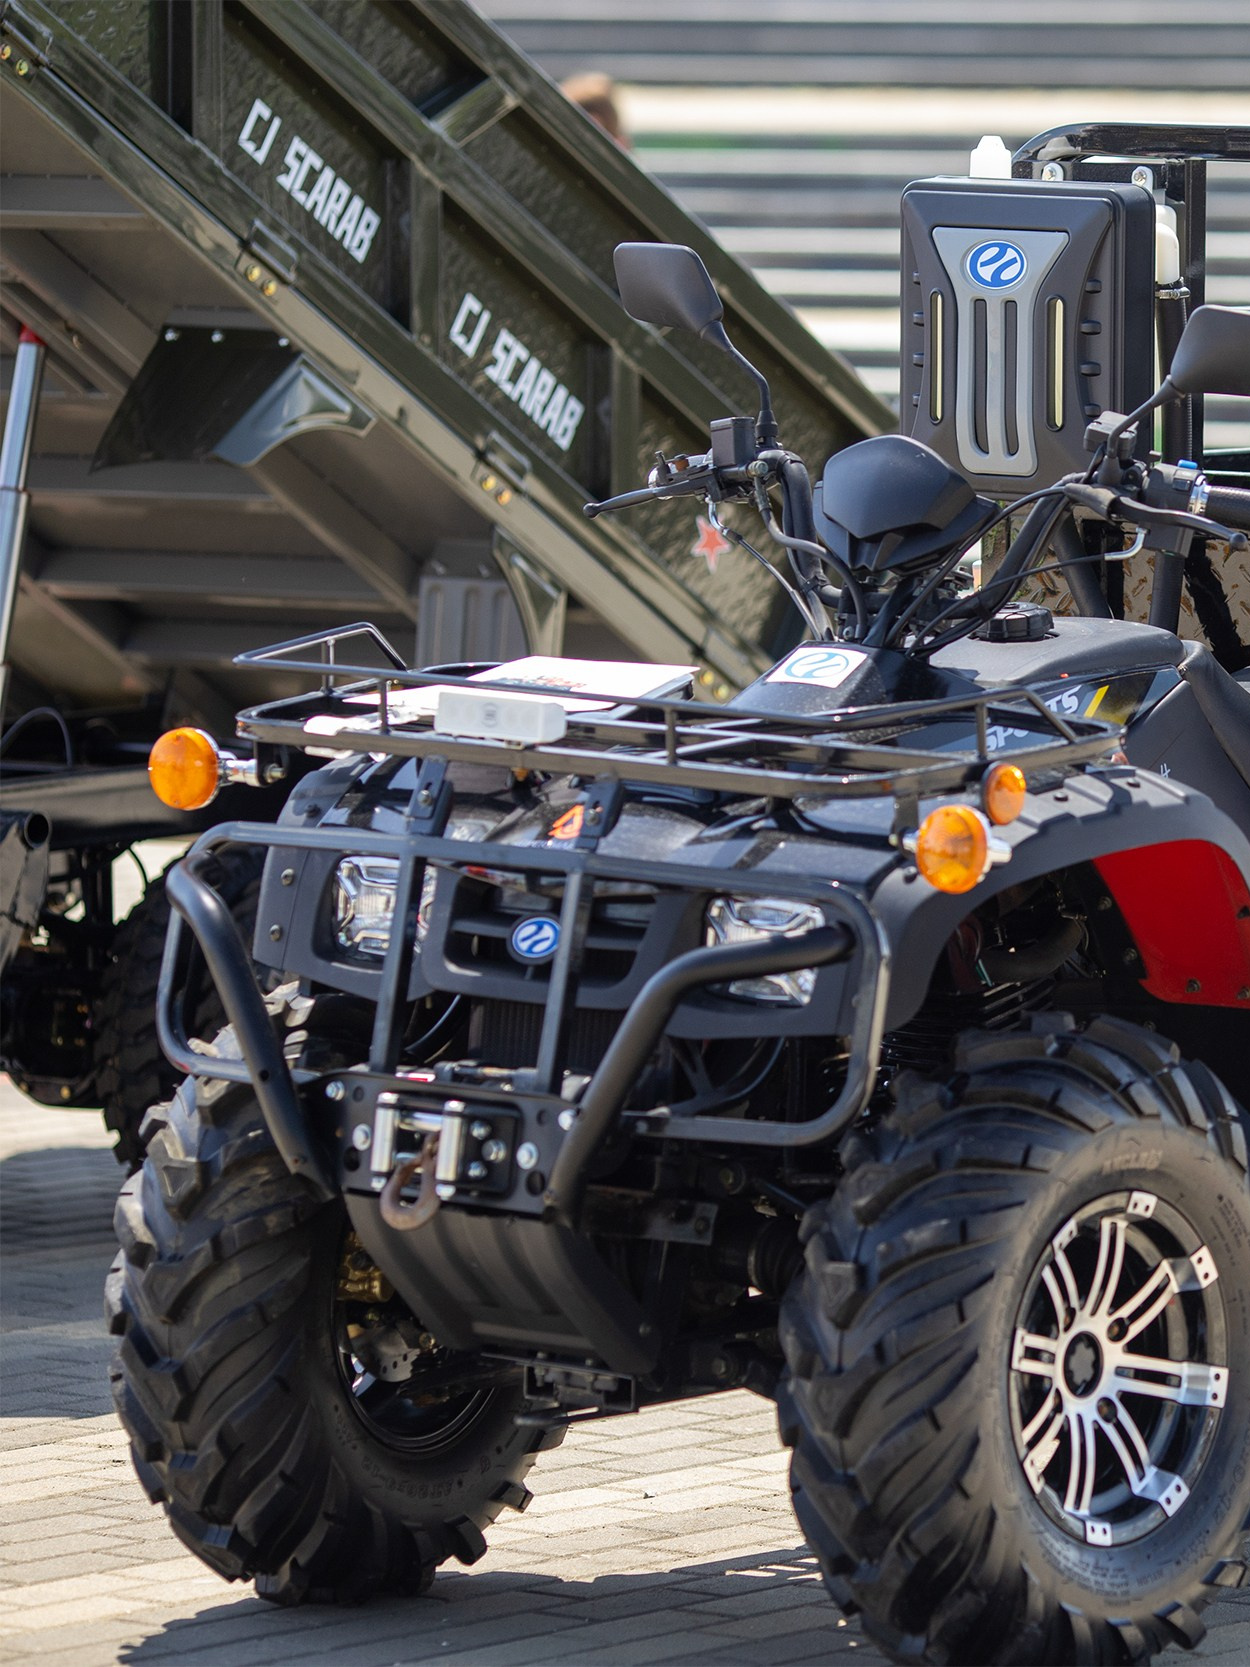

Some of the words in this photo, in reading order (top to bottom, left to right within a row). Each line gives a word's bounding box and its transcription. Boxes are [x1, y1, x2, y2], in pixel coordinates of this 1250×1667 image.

[238, 98, 282, 166] CJ
[275, 135, 382, 264] SCARAB
[449, 292, 491, 359] CJ
[484, 327, 585, 452] SCARAB
